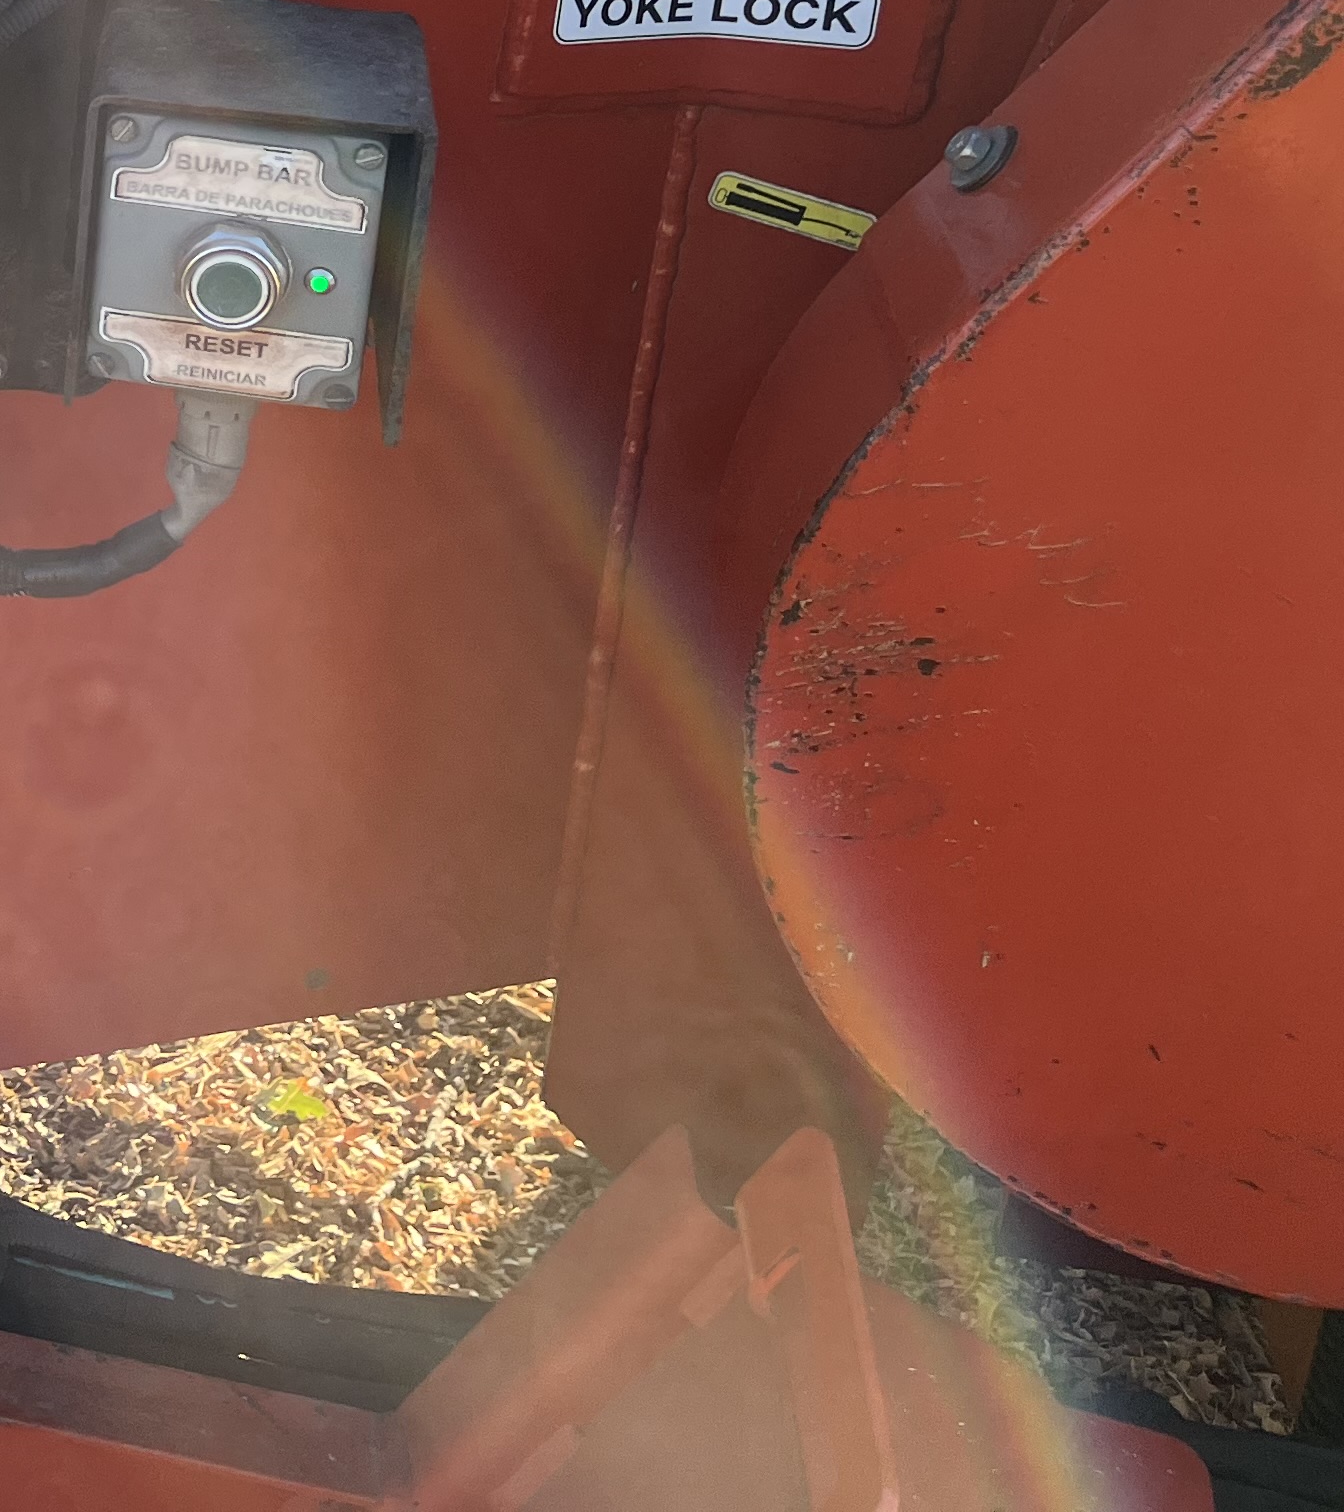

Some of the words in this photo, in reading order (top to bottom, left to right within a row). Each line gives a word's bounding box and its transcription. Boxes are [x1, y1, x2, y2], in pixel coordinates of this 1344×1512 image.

[175, 152, 250, 179] BUMP
[257, 162, 311, 187] BAR
[195, 190, 219, 206] DE
[184, 333, 269, 360] RESET
[176, 363, 267, 388] REINICIAR
